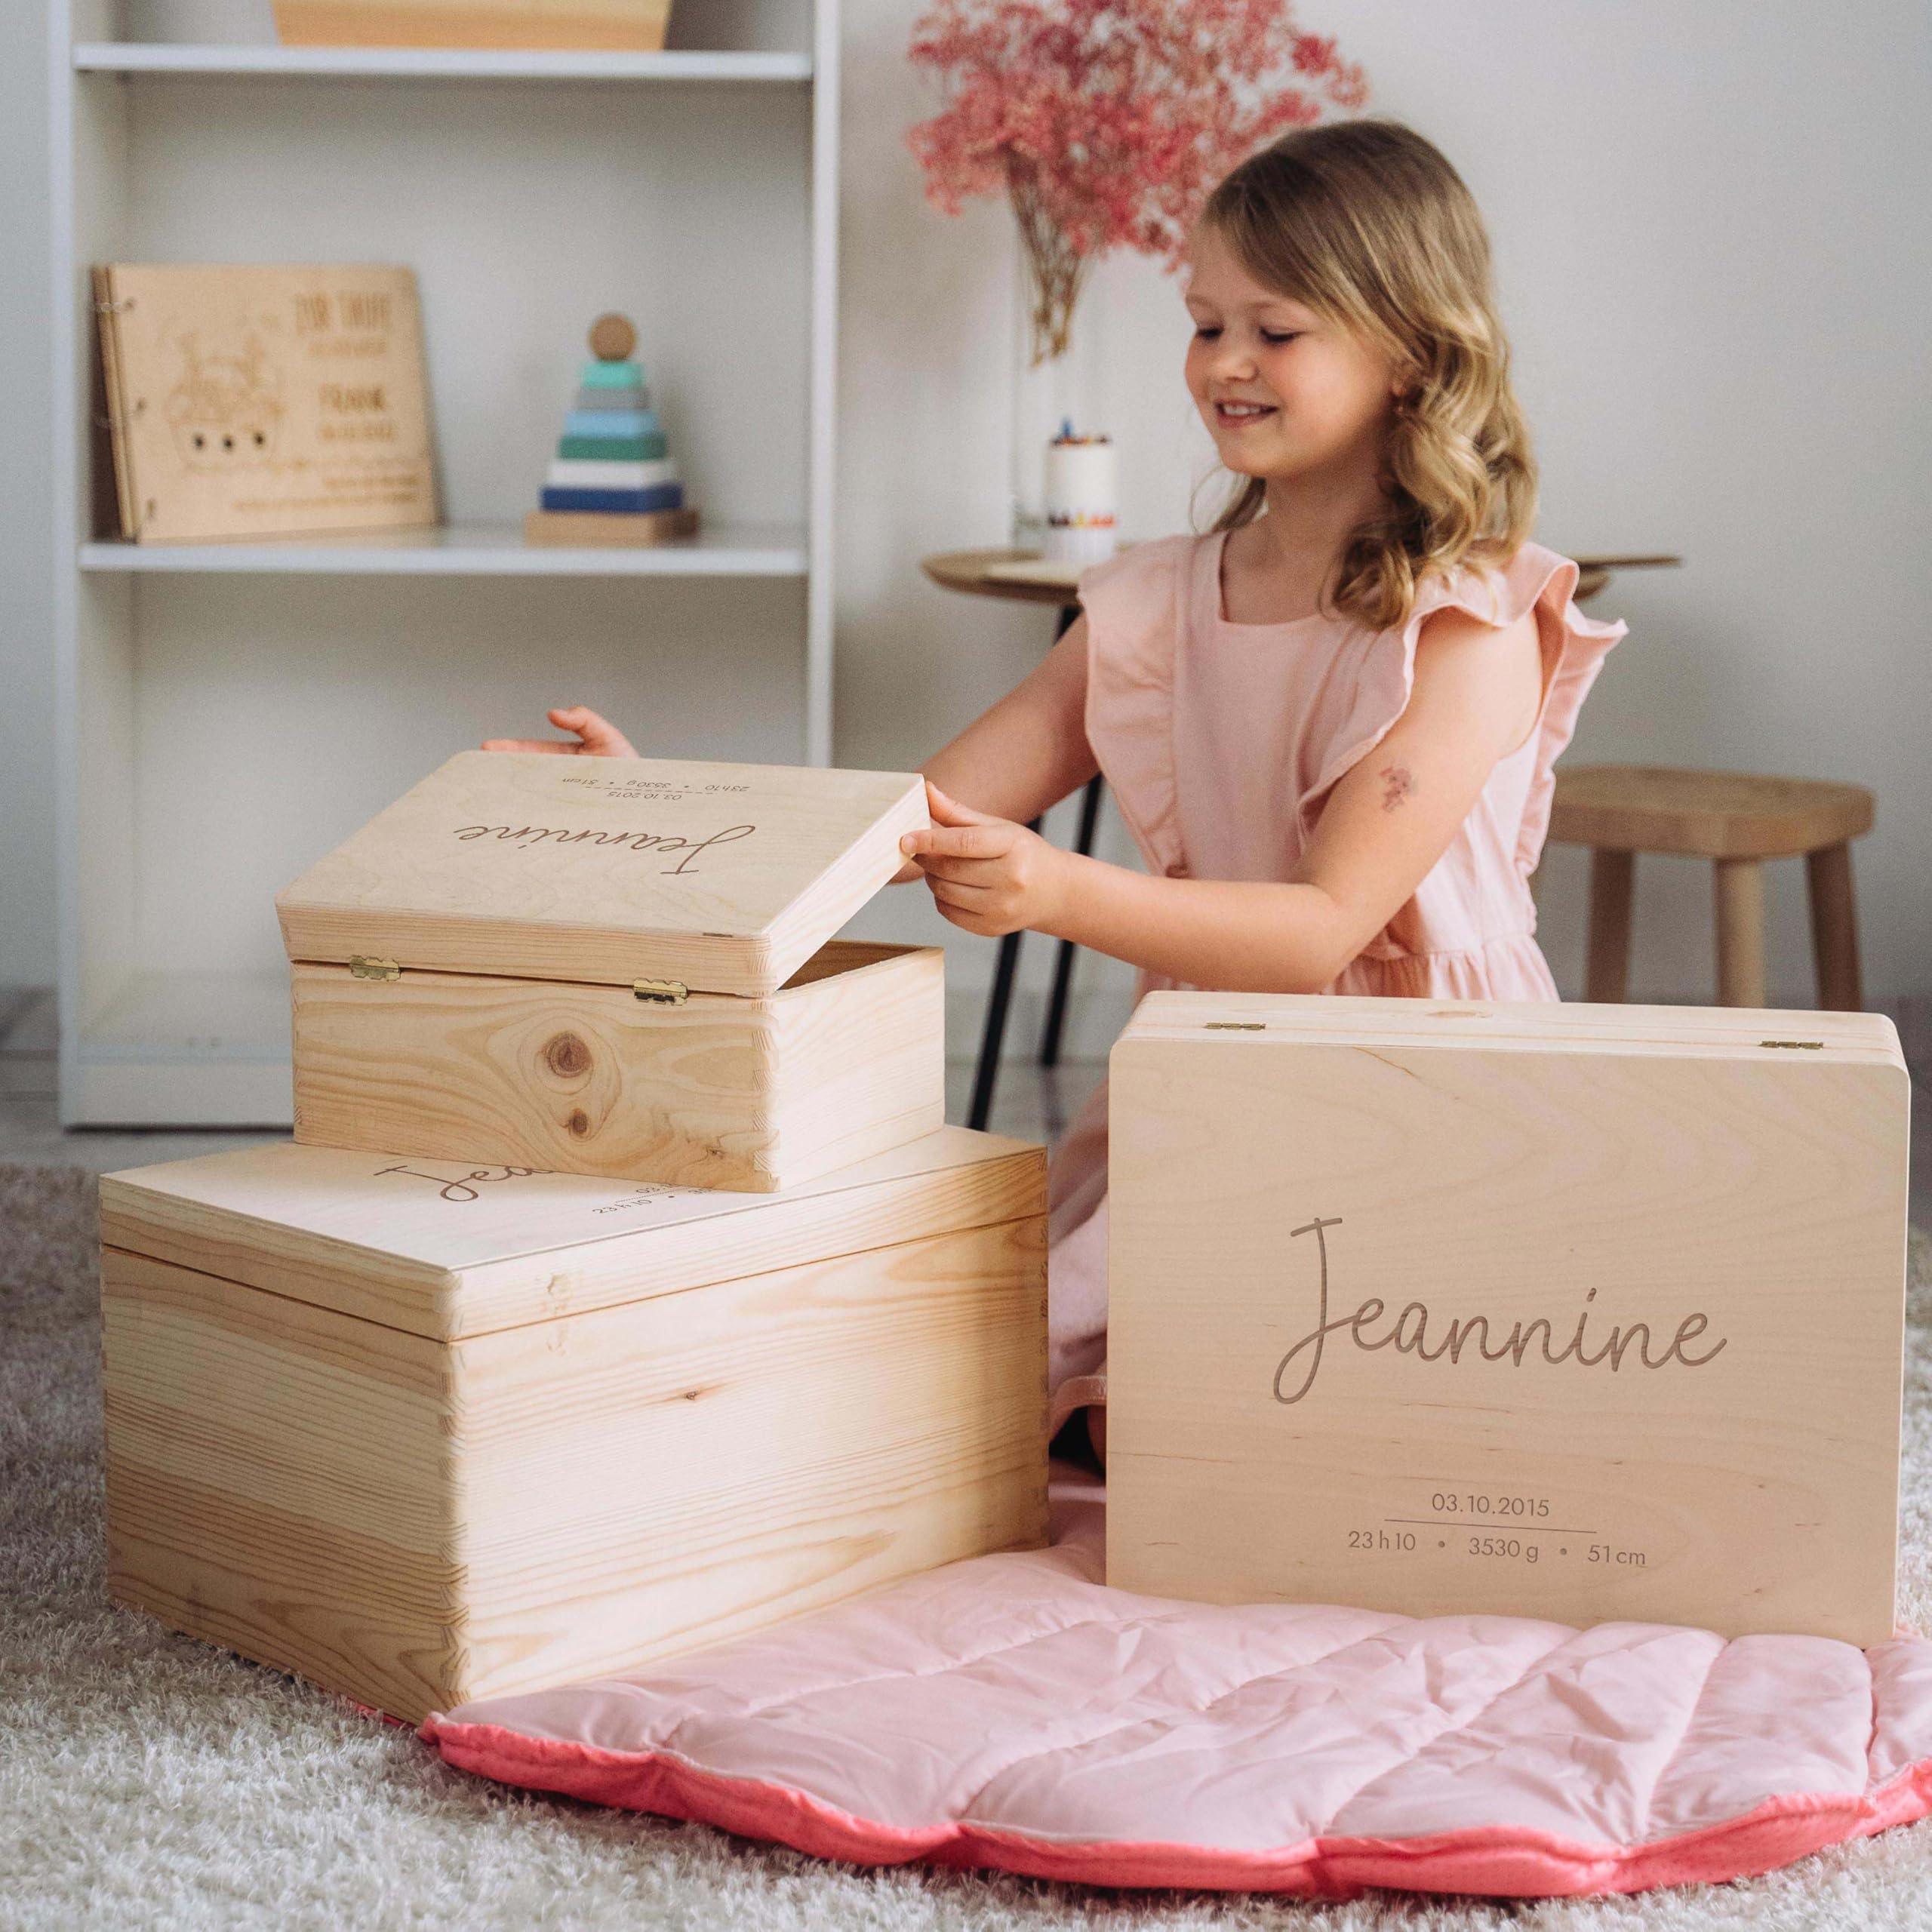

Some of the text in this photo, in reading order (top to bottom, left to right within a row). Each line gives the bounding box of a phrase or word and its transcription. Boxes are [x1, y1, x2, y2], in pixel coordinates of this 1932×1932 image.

[453, 824, 756, 875] Jeannine
[1273, 1217, 1727, 1404] Jeannine
[1432, 1494, 1549, 1516] 03.10.2015
